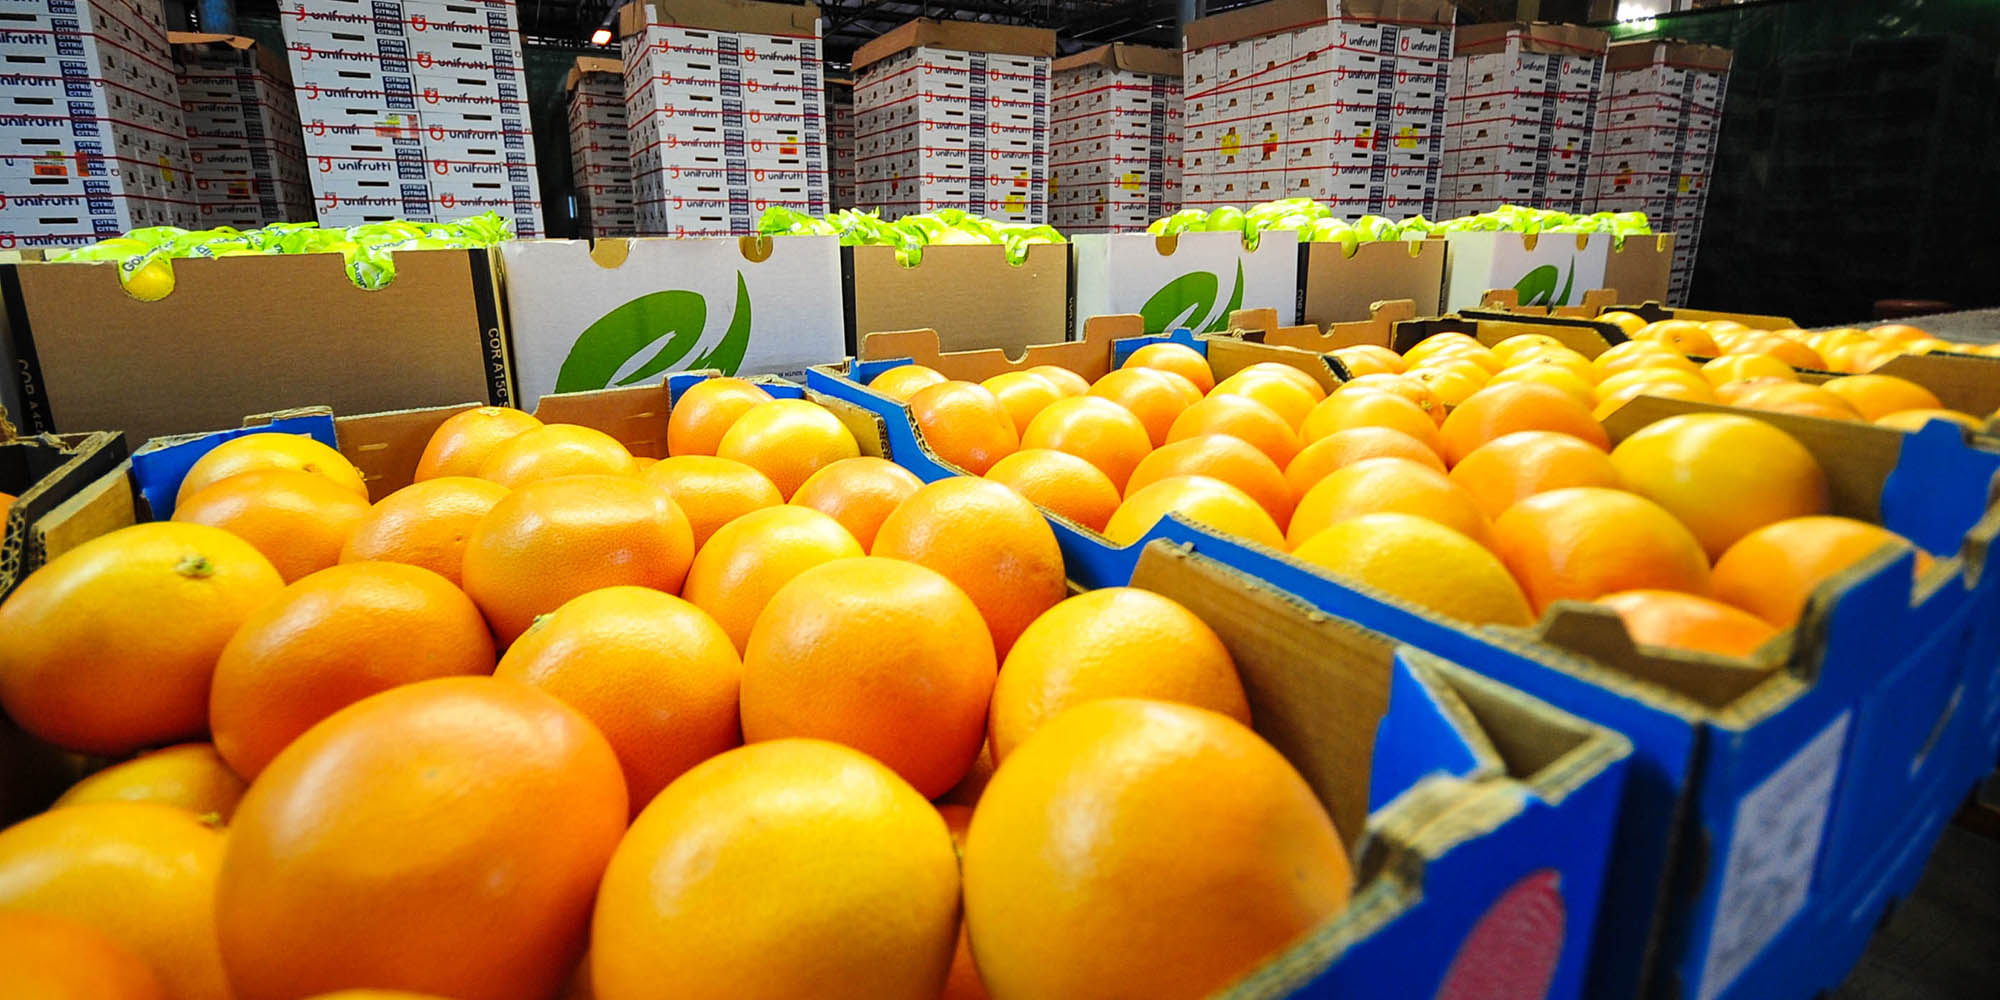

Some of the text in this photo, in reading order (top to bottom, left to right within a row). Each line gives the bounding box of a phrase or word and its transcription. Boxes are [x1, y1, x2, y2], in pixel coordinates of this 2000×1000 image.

[312, 10, 367, 24] unifrutti
[319, 49, 373, 61] unifrutti
[325, 87, 379, 99] unifrutti
[338, 159, 391, 171] unifrutti
[344, 195, 397, 206] unifrutti
[488, 328, 502, 359] COR
